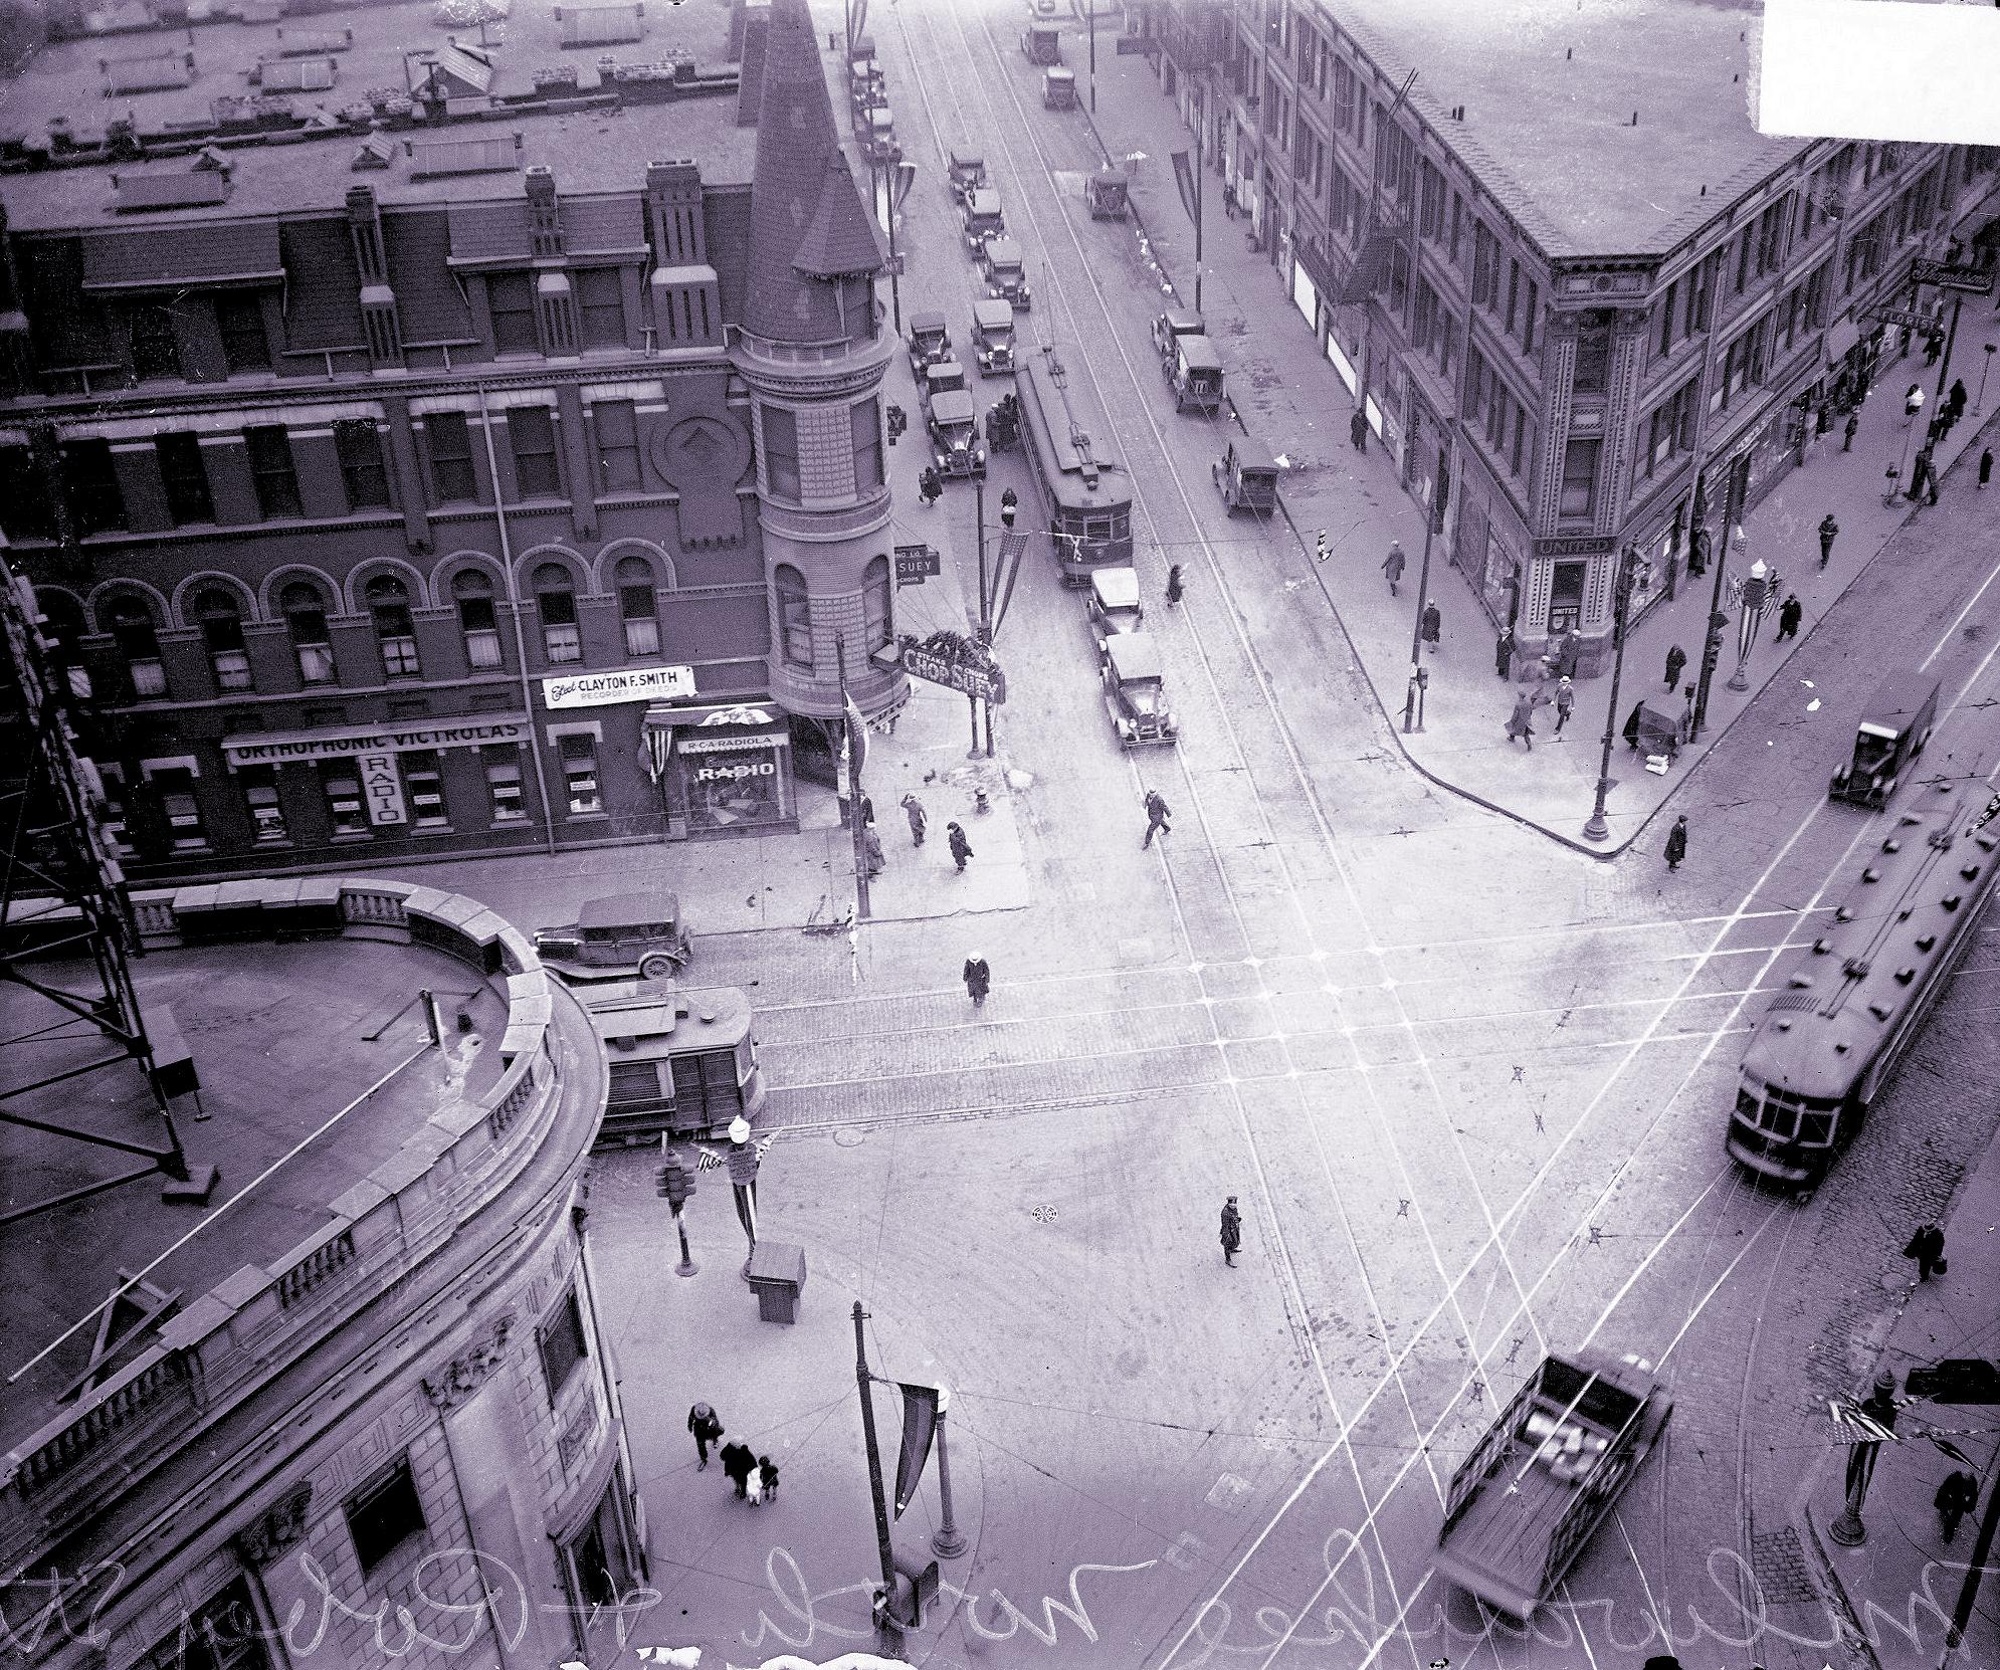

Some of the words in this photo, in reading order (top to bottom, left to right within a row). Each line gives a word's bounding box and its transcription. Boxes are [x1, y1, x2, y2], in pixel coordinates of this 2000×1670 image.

[900, 560, 931, 572] SUEY
[904, 648, 949, 683] CHOP
[951, 664, 999, 701] SUEY
[551, 681, 577, 701] Elect
[578, 676, 627, 692] CLAYTON
[237, 735, 388, 760] ORTHOPHONIC
[398, 723, 519, 748] VICTROLAS
[718, 737, 772, 746] RADIOLA
[698, 763, 775, 781] RADIO
[367, 758, 400, 822] RADIO
